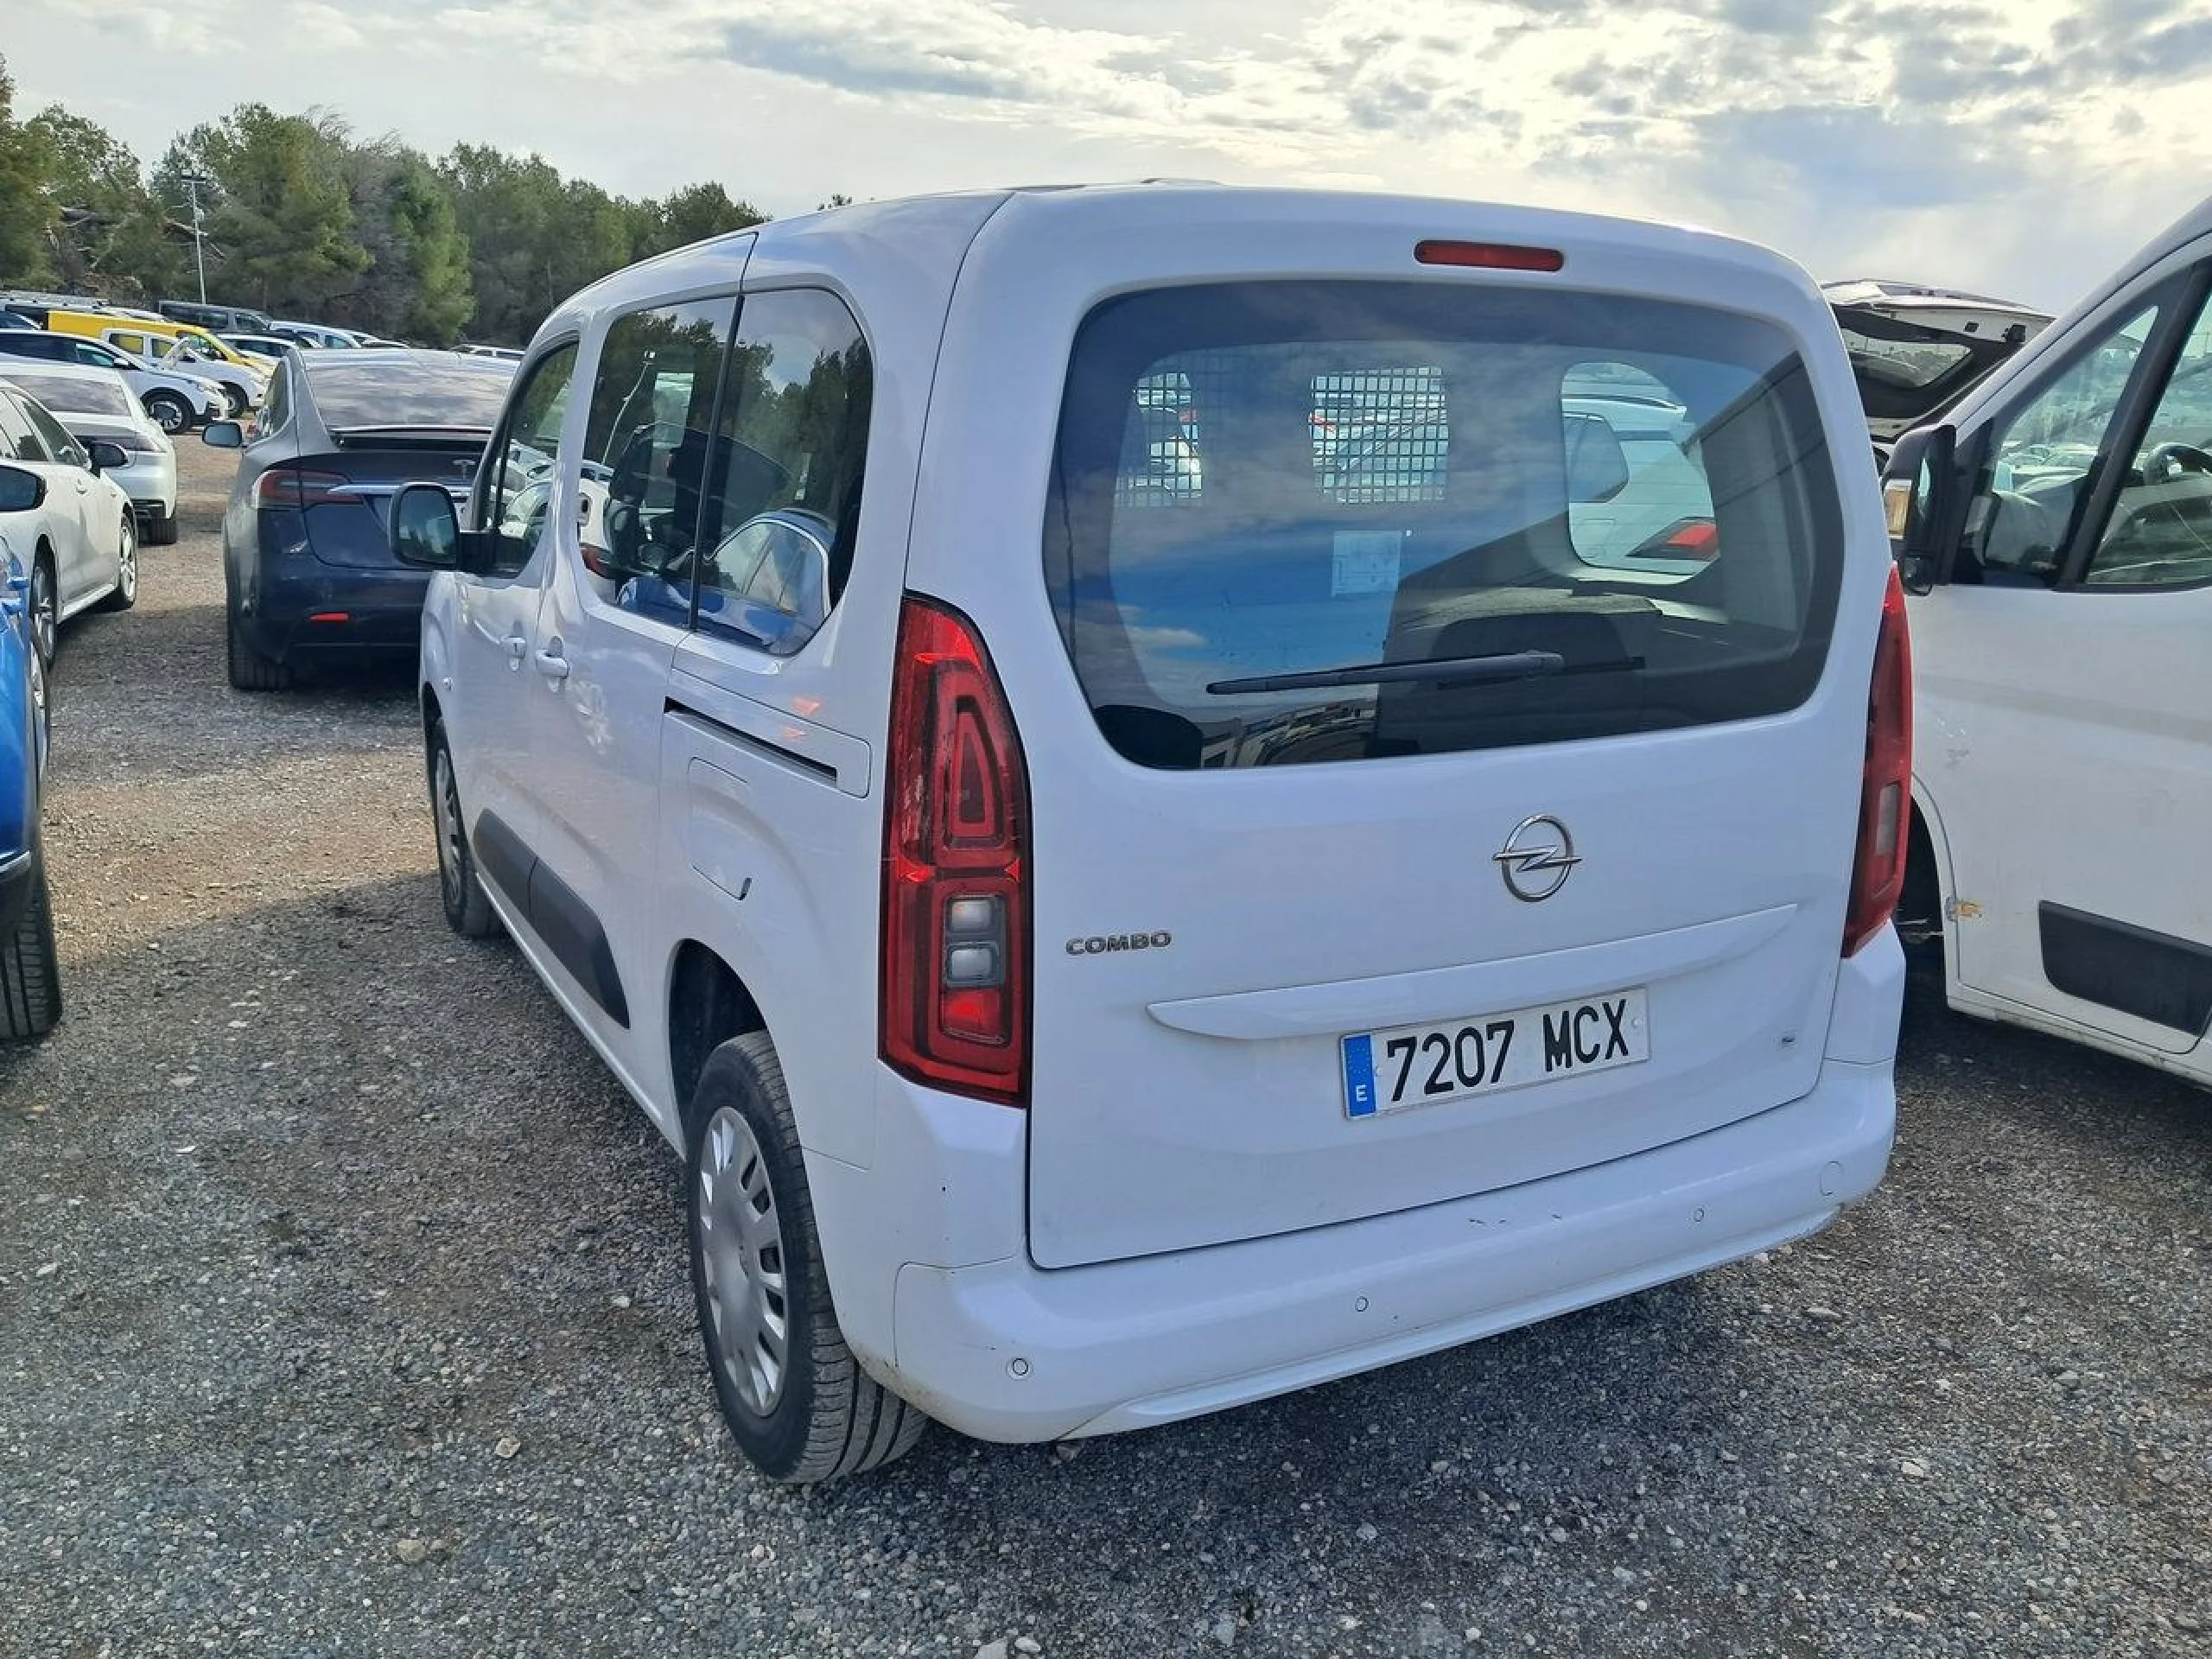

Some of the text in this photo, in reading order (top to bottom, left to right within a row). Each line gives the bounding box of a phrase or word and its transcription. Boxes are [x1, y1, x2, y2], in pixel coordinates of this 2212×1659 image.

[1065, 930, 1173, 956] COMBO
[1387, 998, 1630, 1102] 7207 MCX
[1355, 1084, 1368, 1103] E
